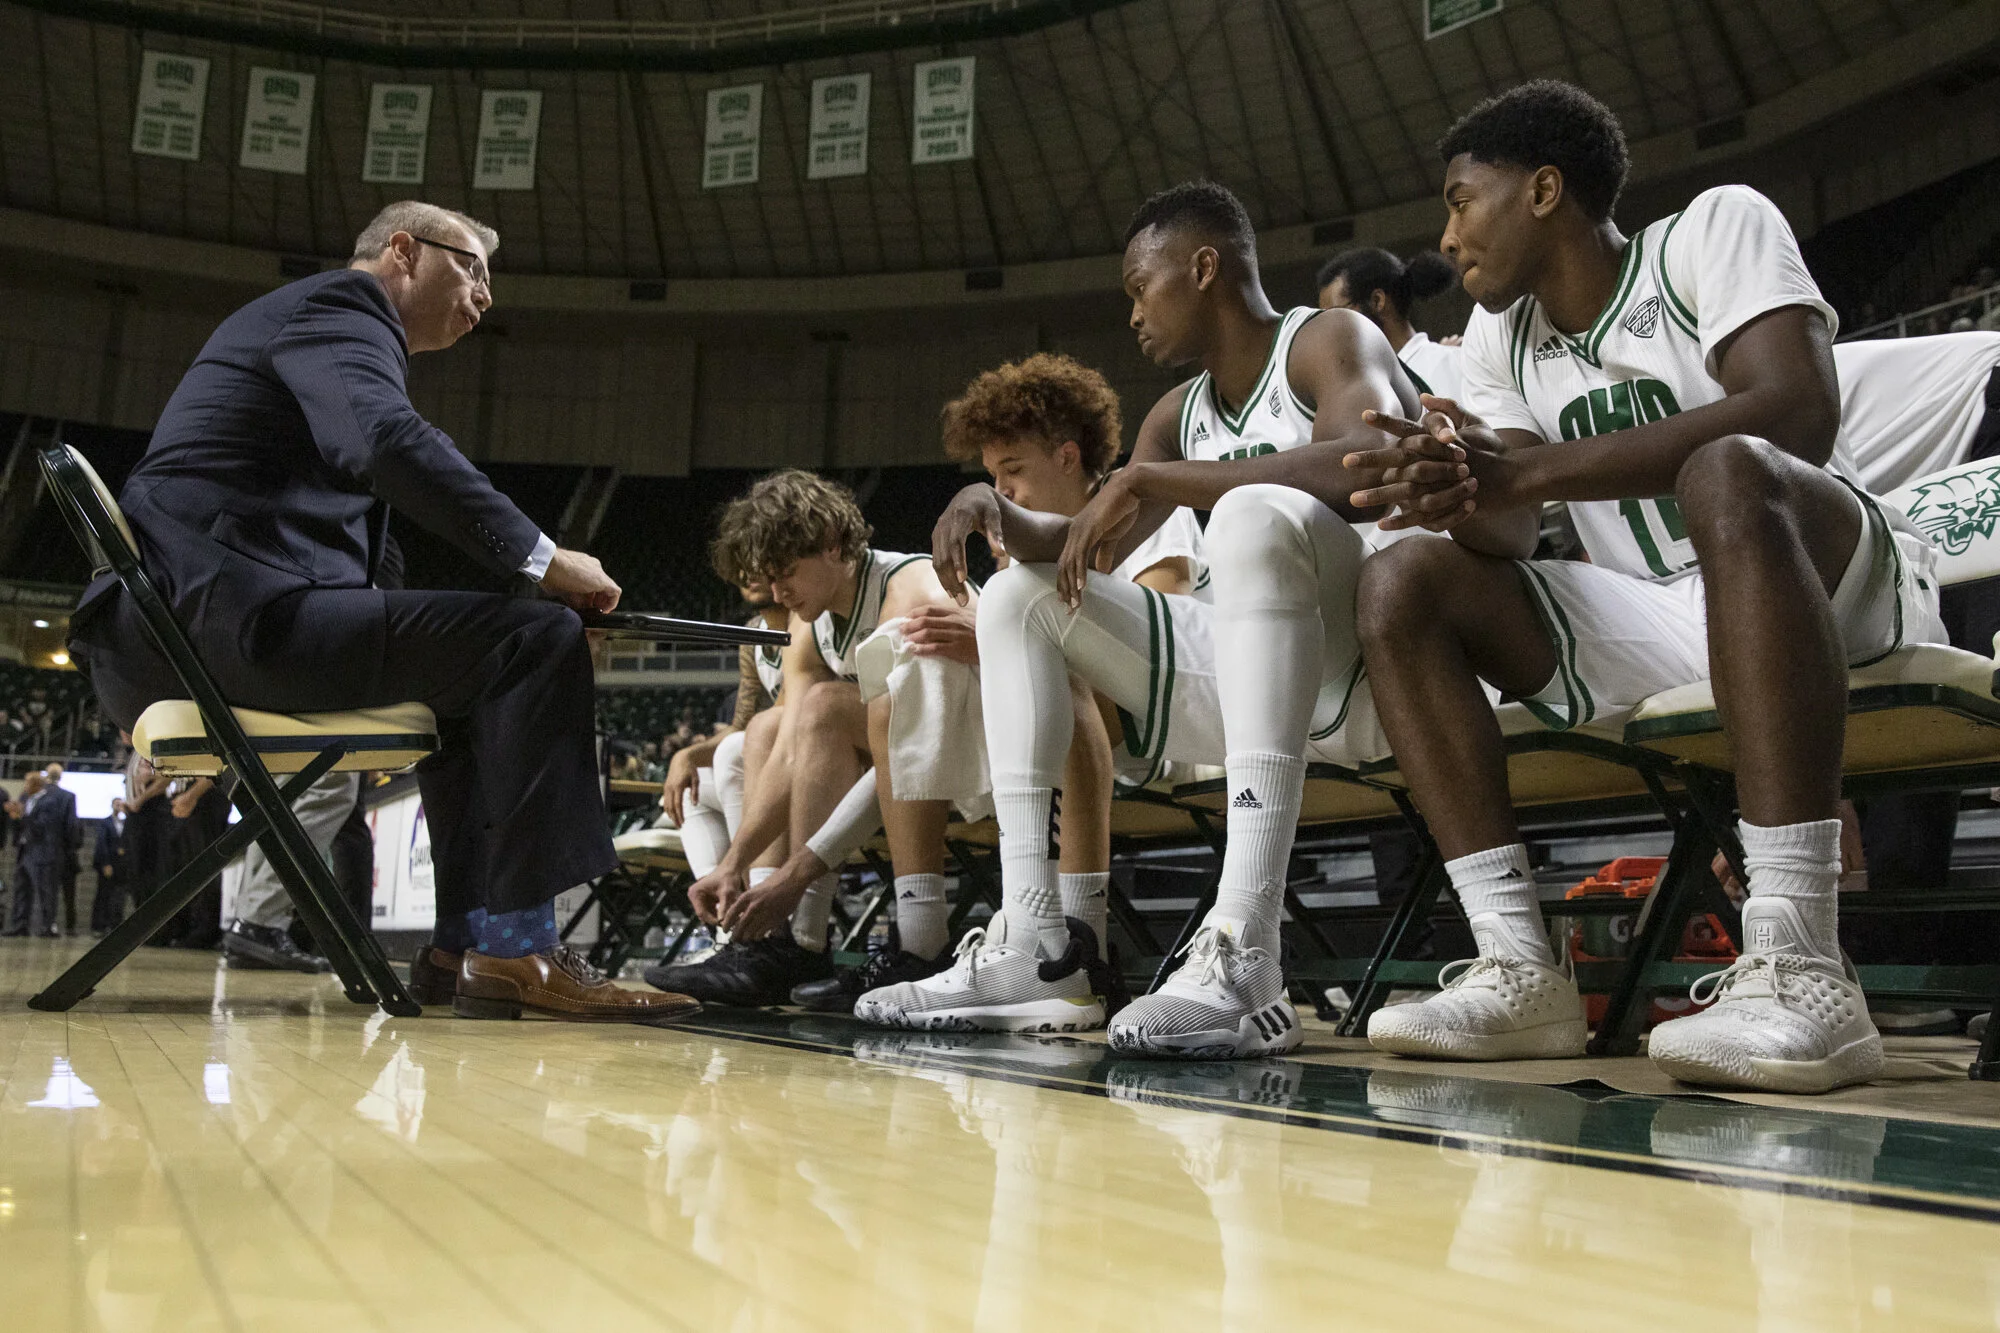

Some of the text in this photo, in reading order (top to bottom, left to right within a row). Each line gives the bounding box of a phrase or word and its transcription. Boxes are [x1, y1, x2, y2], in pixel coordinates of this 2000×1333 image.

[156, 59, 194, 84] OHIO
[824, 82, 857, 104] OHIO
[1533, 350, 1568, 363] adidas
[1233, 799, 1263, 809] adidas
